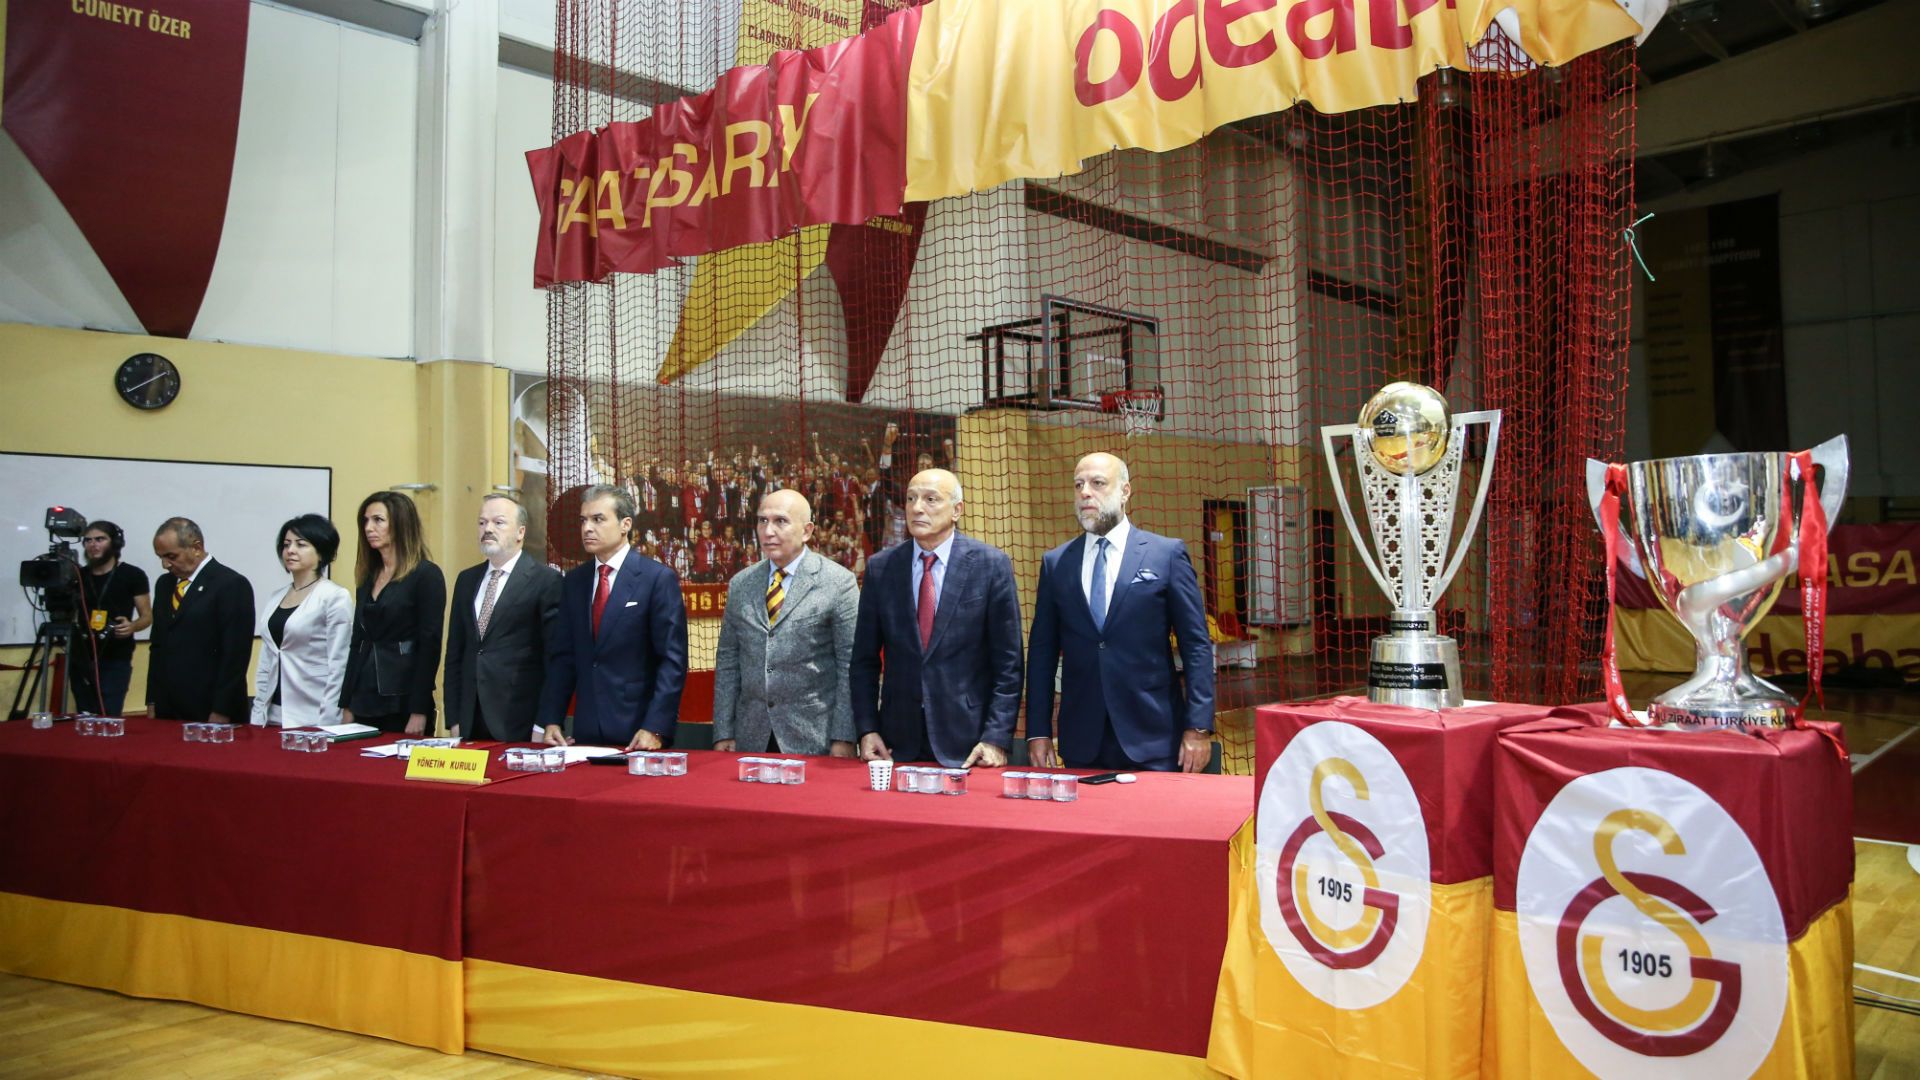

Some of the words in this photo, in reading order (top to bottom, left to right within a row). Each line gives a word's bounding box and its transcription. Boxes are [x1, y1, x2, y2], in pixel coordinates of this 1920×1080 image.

[148, 9, 191, 39] ÖZER
[416, 756, 446, 769] YÖNETİM
[450, 760, 477, 771] KURULU
[1317, 876, 1353, 902] 1905
[1618, 948, 1673, 978] 1905
